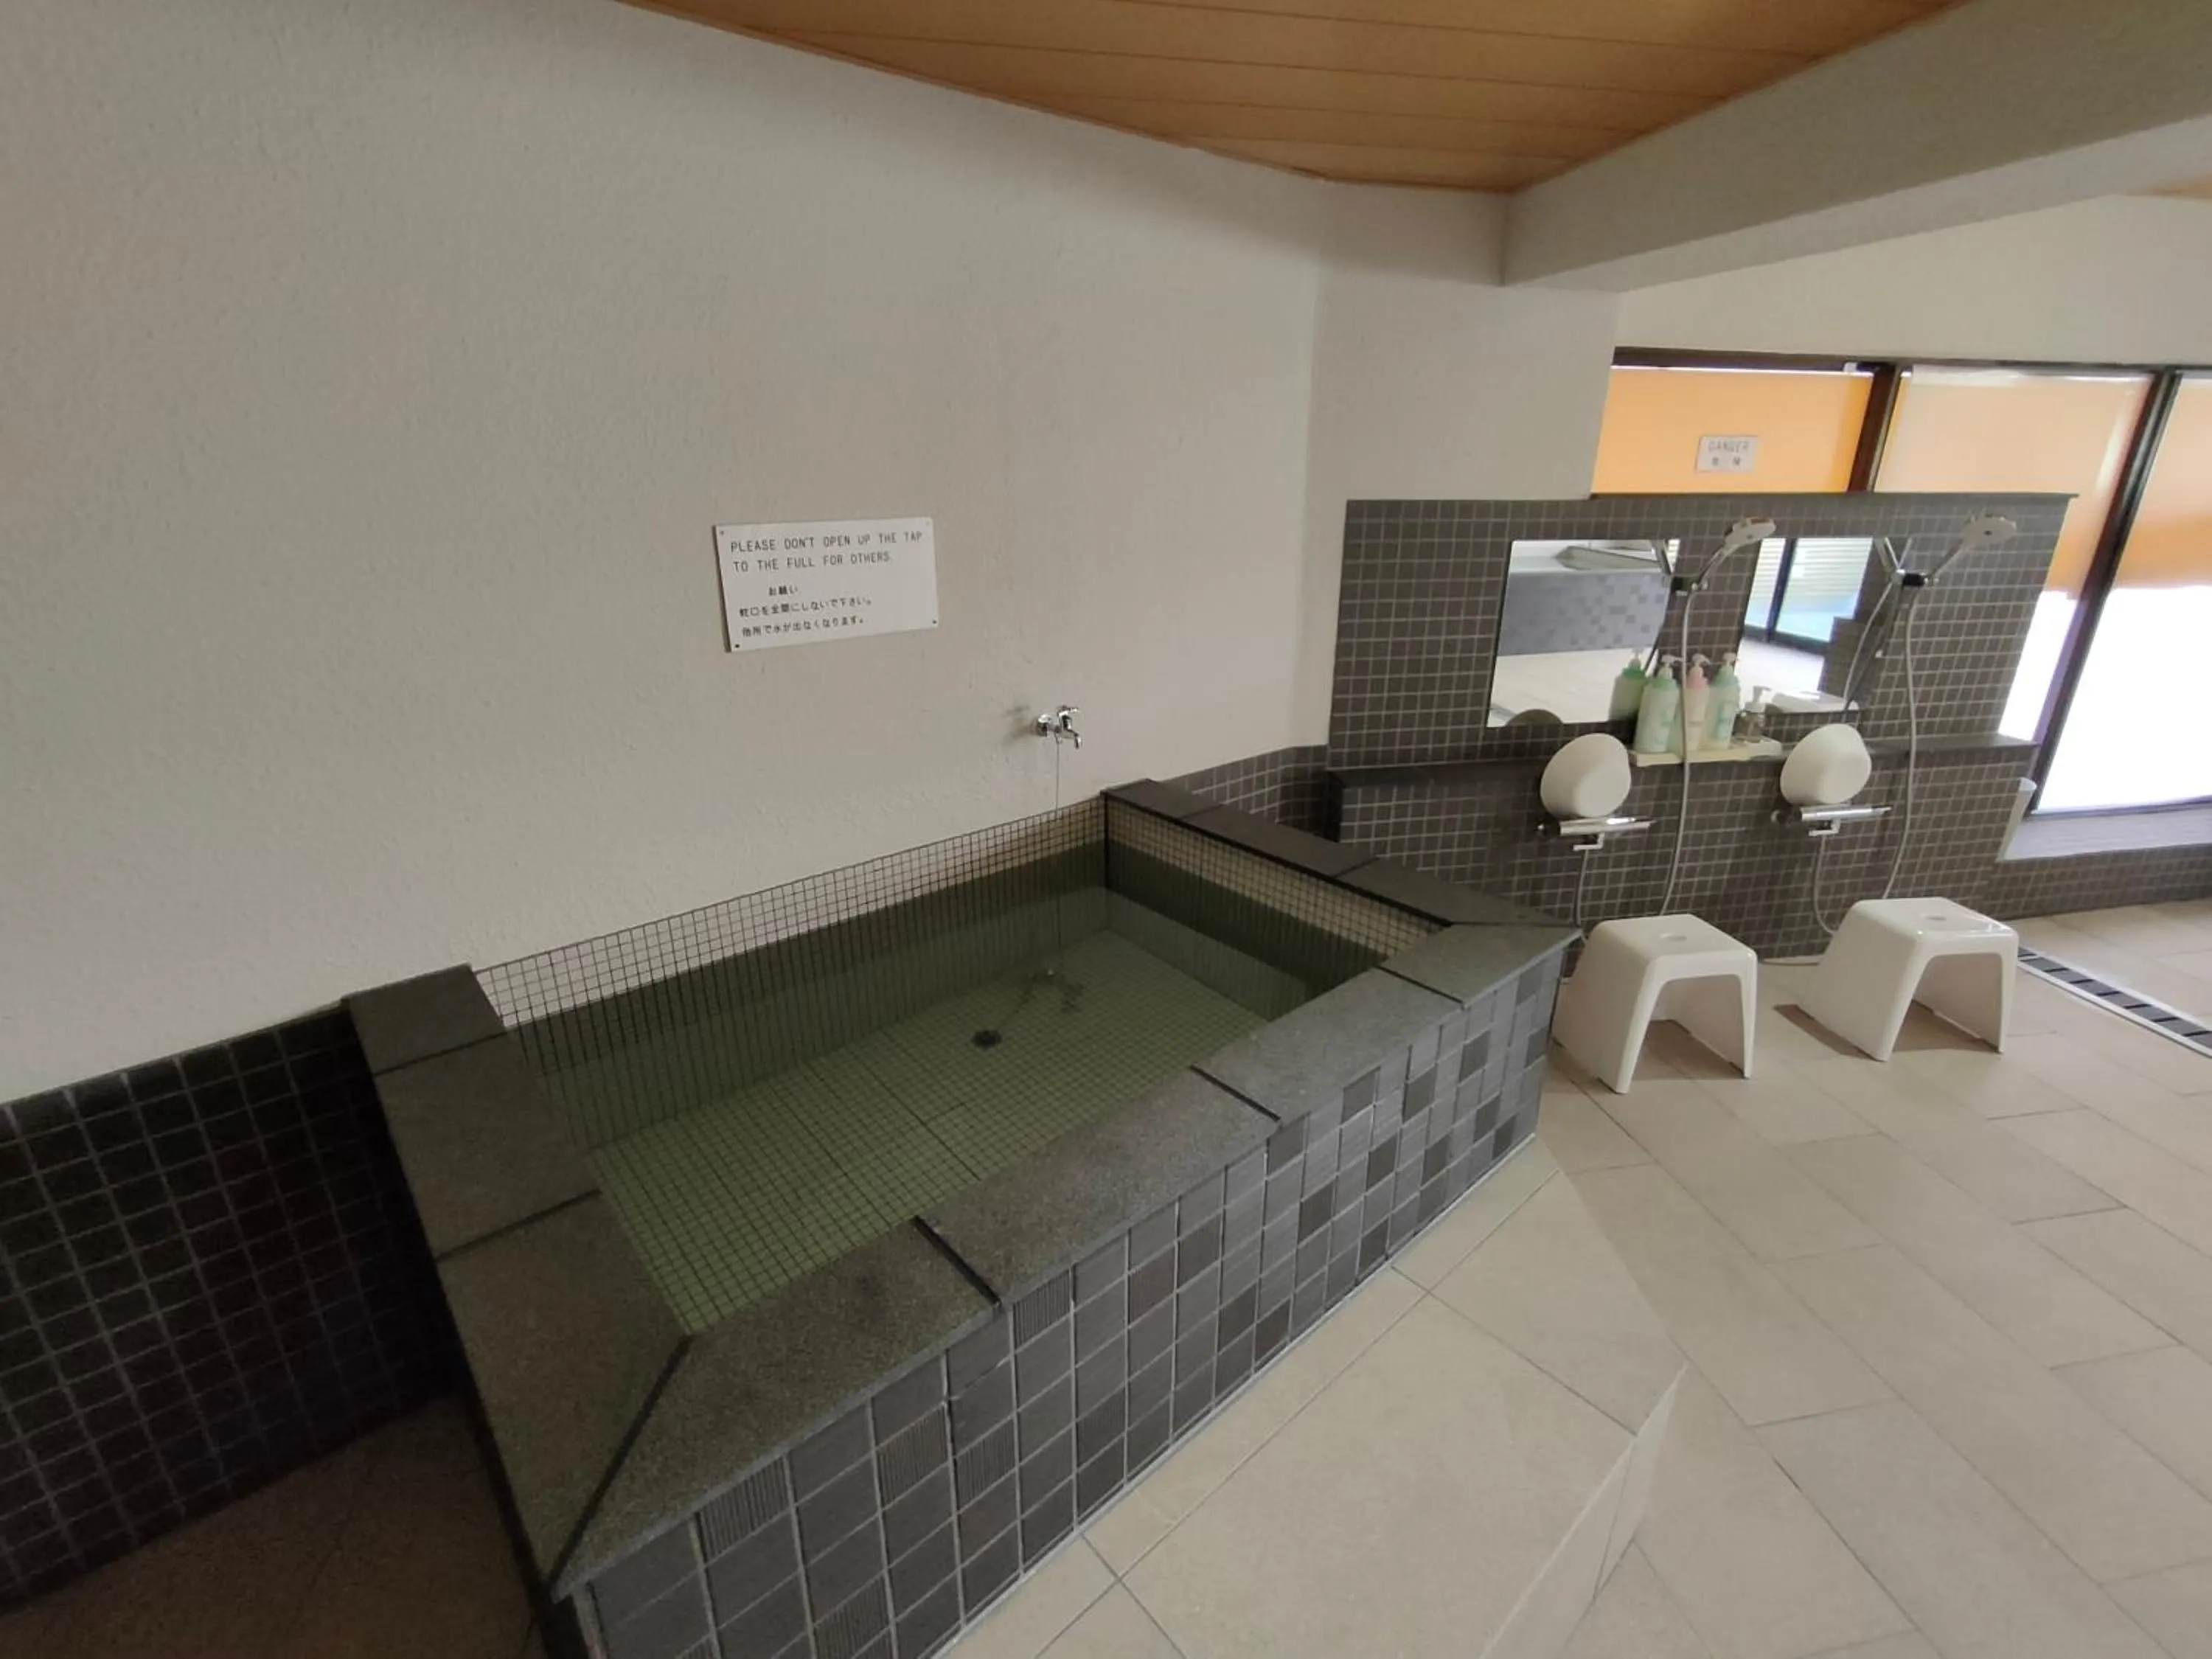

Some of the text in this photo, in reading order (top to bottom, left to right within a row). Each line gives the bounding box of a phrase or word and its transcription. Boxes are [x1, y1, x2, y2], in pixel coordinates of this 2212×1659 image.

[731, 530, 923, 553] PLEASE DON'T OPEN UP THE TAP
[733, 560, 748, 572] TO
[757, 558, 779, 571] THE
[787, 557, 815, 568] FULL
[823, 554, 843, 566] FOR
